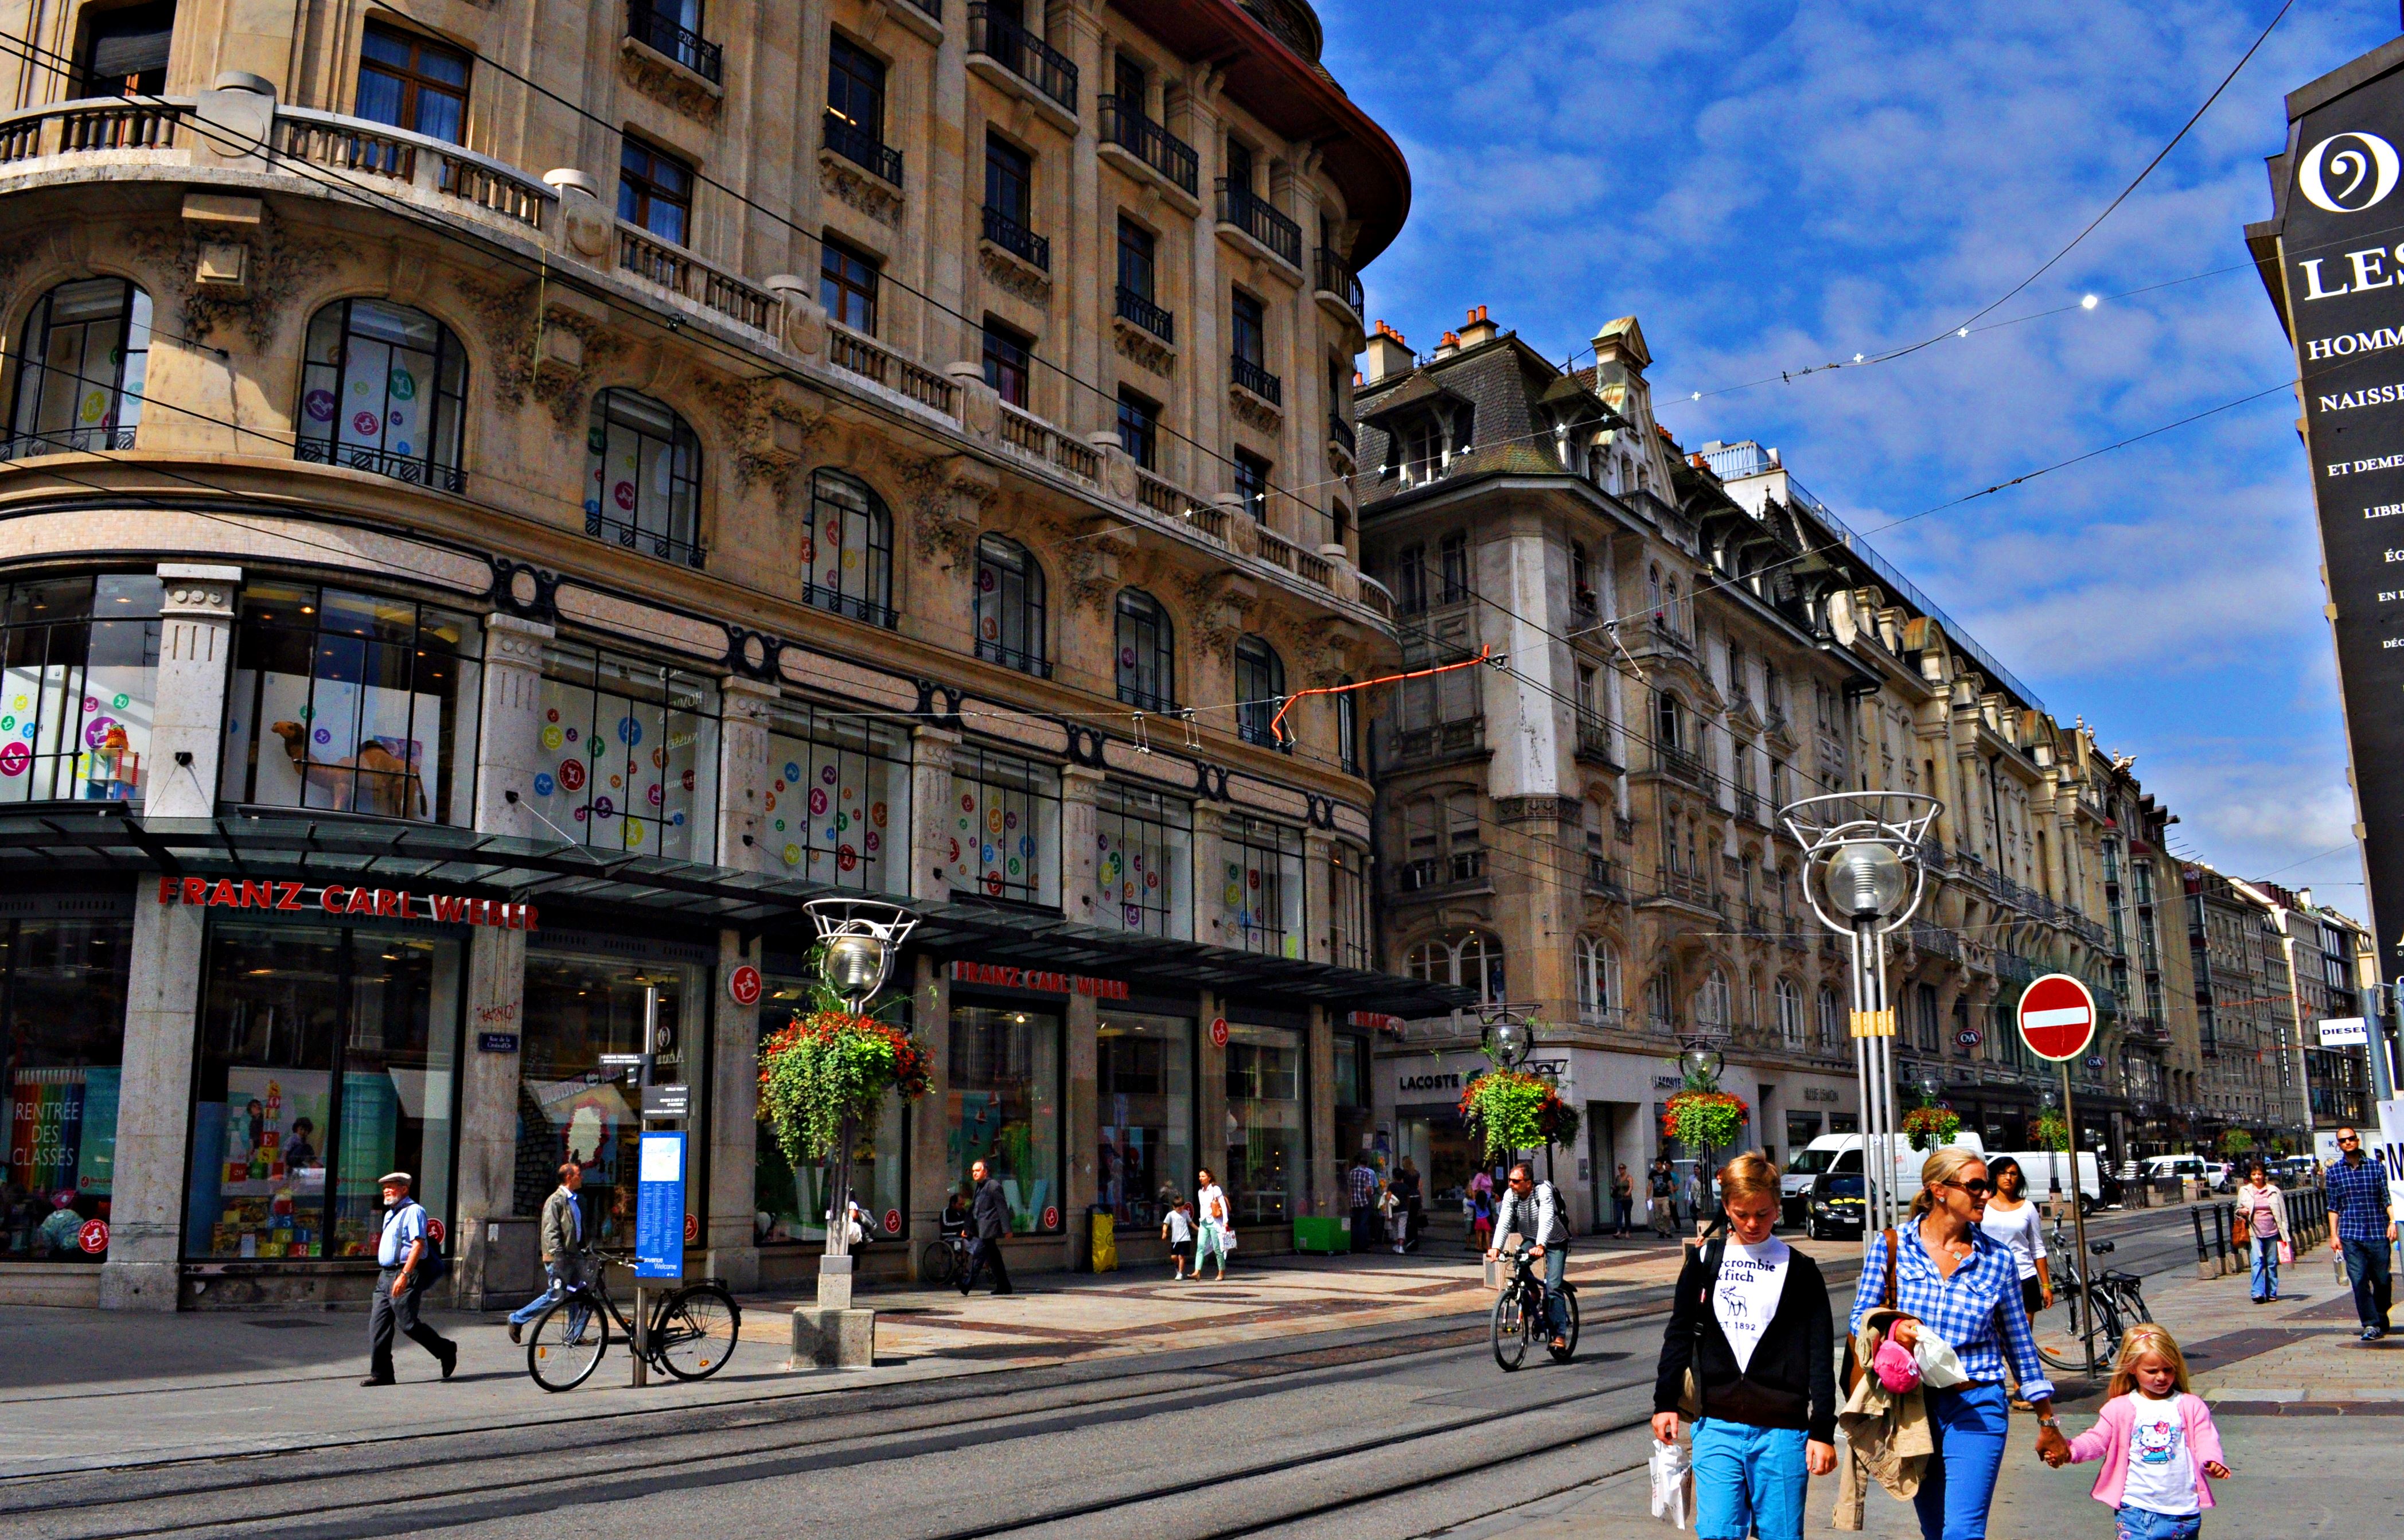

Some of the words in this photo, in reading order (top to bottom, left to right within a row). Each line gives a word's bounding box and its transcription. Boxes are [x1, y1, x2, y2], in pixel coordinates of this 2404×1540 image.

[2298, 241, 2404, 301] LE
[2327, 462, 2350, 477] ET
[2378, 591, 2396, 601] EN
[158, 876, 305, 910] FRANZ
[320, 884, 419, 918] CARL
[428, 893, 540, 931] WEBER
[952, 960, 1020, 988] FRANZ
[1024, 969, 1071, 993] CARL
[1074, 975, 1129, 1001] WEBER
[1399, 1074, 1459, 1090] LACOSTE
[15, 1098, 80, 1120] RENTRÉE
[31, 1125, 59, 1143] DES
[13, 1148, 74, 1166] CLASSES
[1721, 1258, 1776, 1272] crombie
[1724, 1269, 1754, 1282] fitch
[1735, 1321, 1756, 1331] 1892
